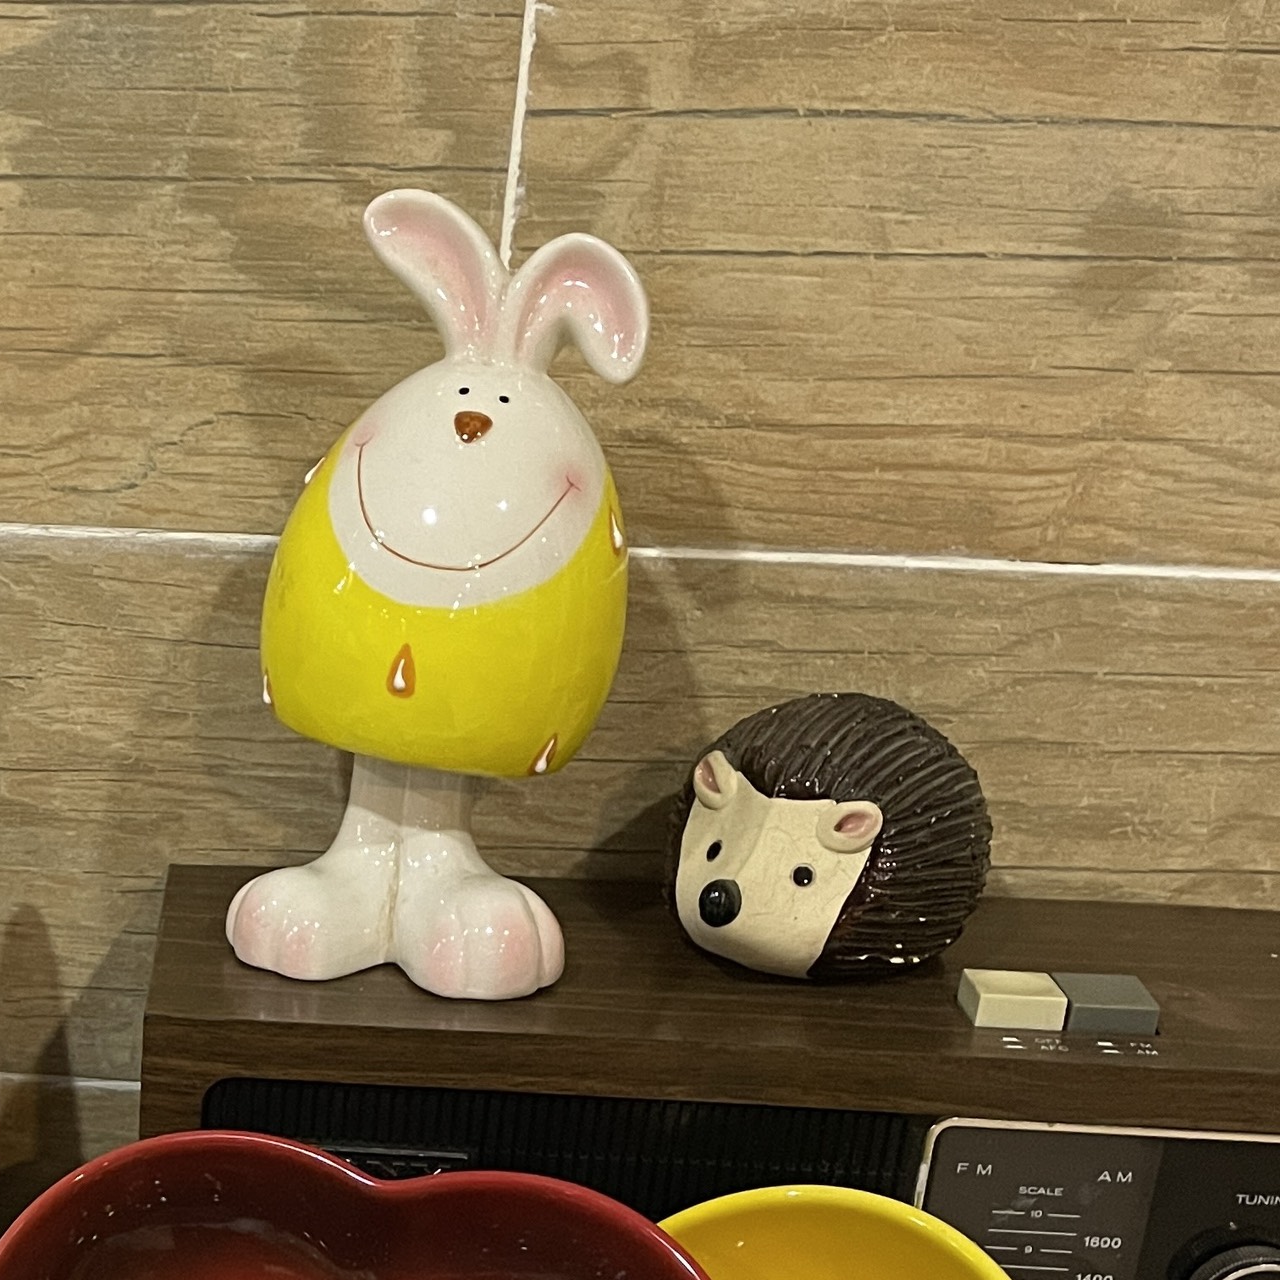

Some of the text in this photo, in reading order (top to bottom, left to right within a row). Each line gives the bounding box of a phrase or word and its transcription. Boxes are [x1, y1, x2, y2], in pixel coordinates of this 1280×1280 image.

[1097, 1170, 1133, 1184] AM
[1019, 1186, 1064, 1197] SCALE
[1083, 1235, 1122, 1250] 1600
